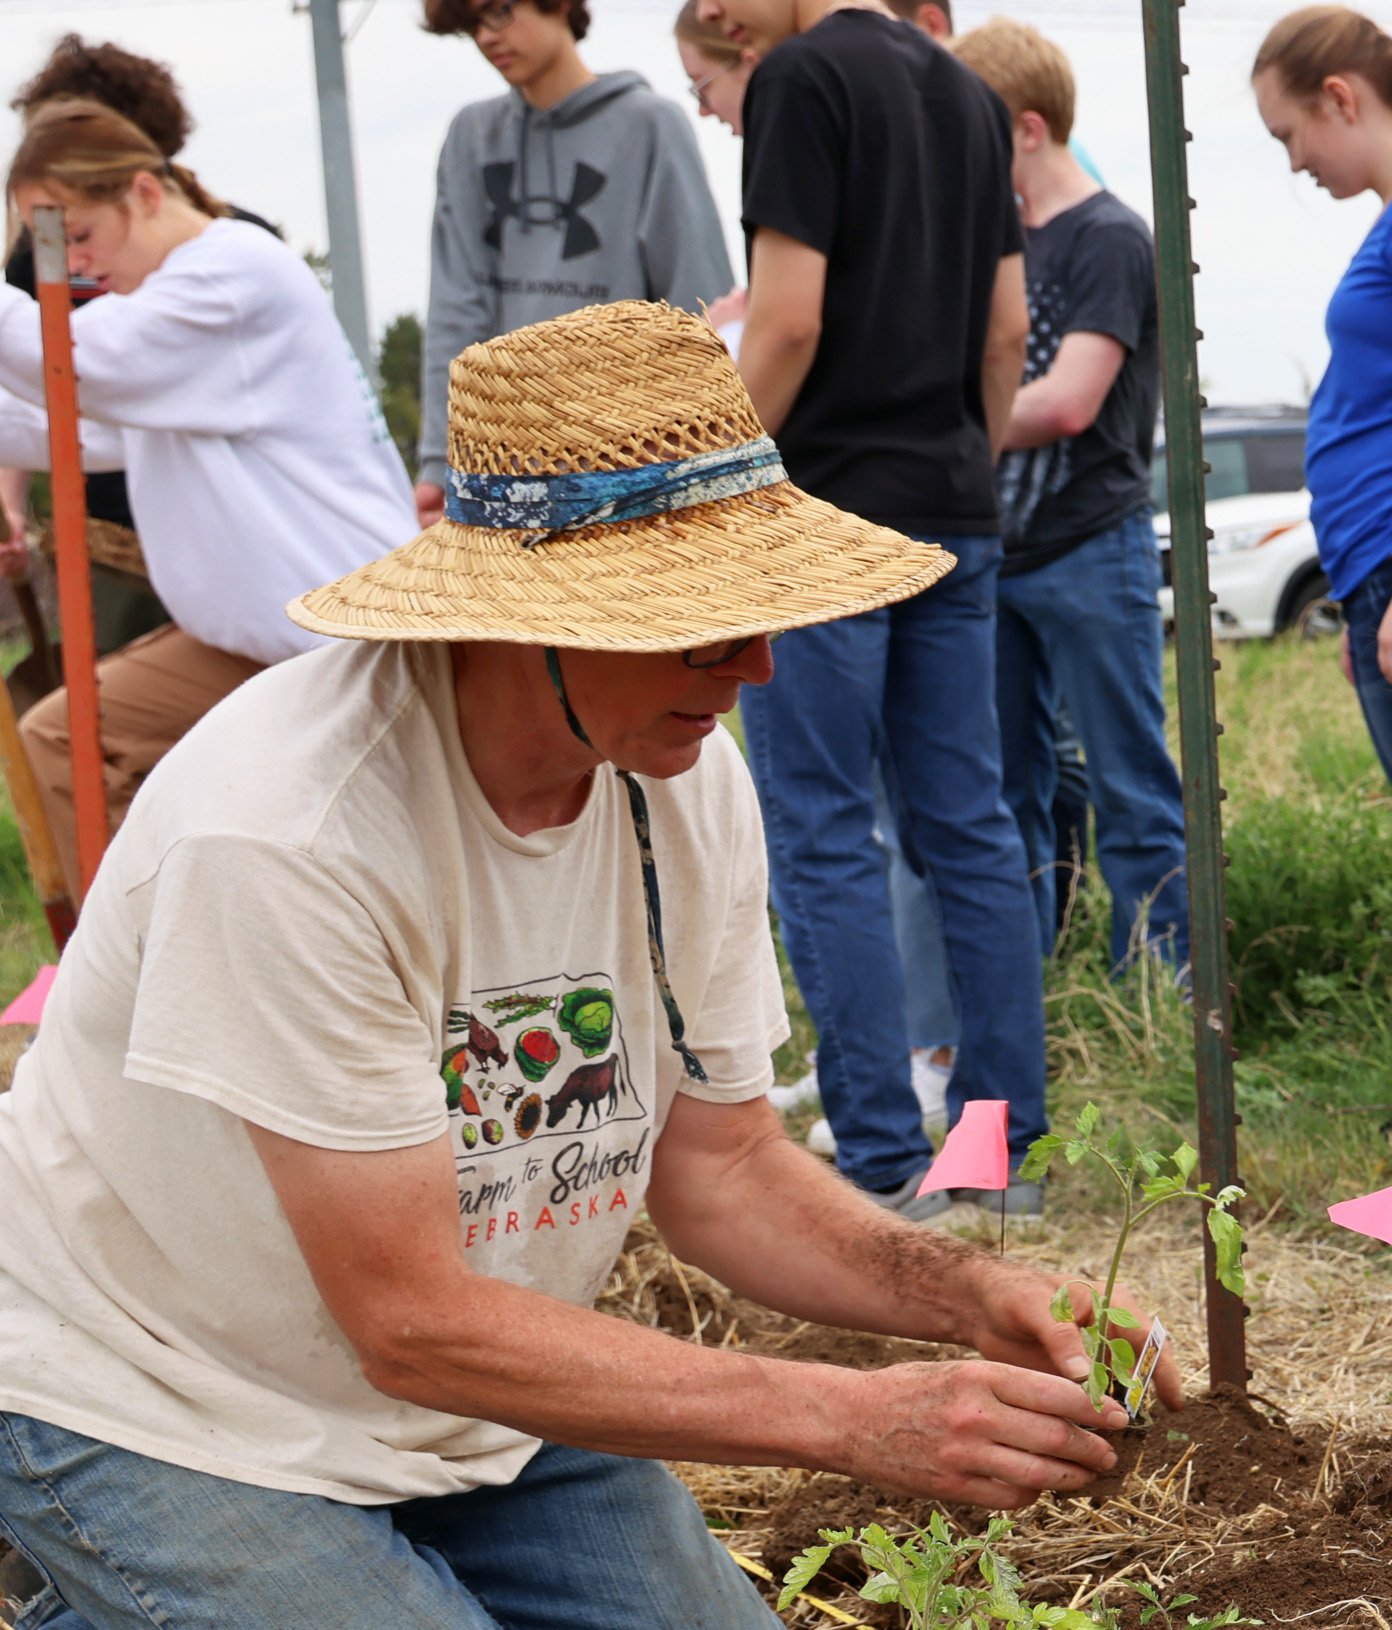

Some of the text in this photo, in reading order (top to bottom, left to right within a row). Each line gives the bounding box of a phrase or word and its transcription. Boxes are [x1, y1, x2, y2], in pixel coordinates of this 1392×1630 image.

[525, 277, 611, 298] ARMOUR
[522, 1156, 544, 1184] to
[550, 1126, 650, 1204] School
[465, 1187, 629, 1248] EBRASKA
